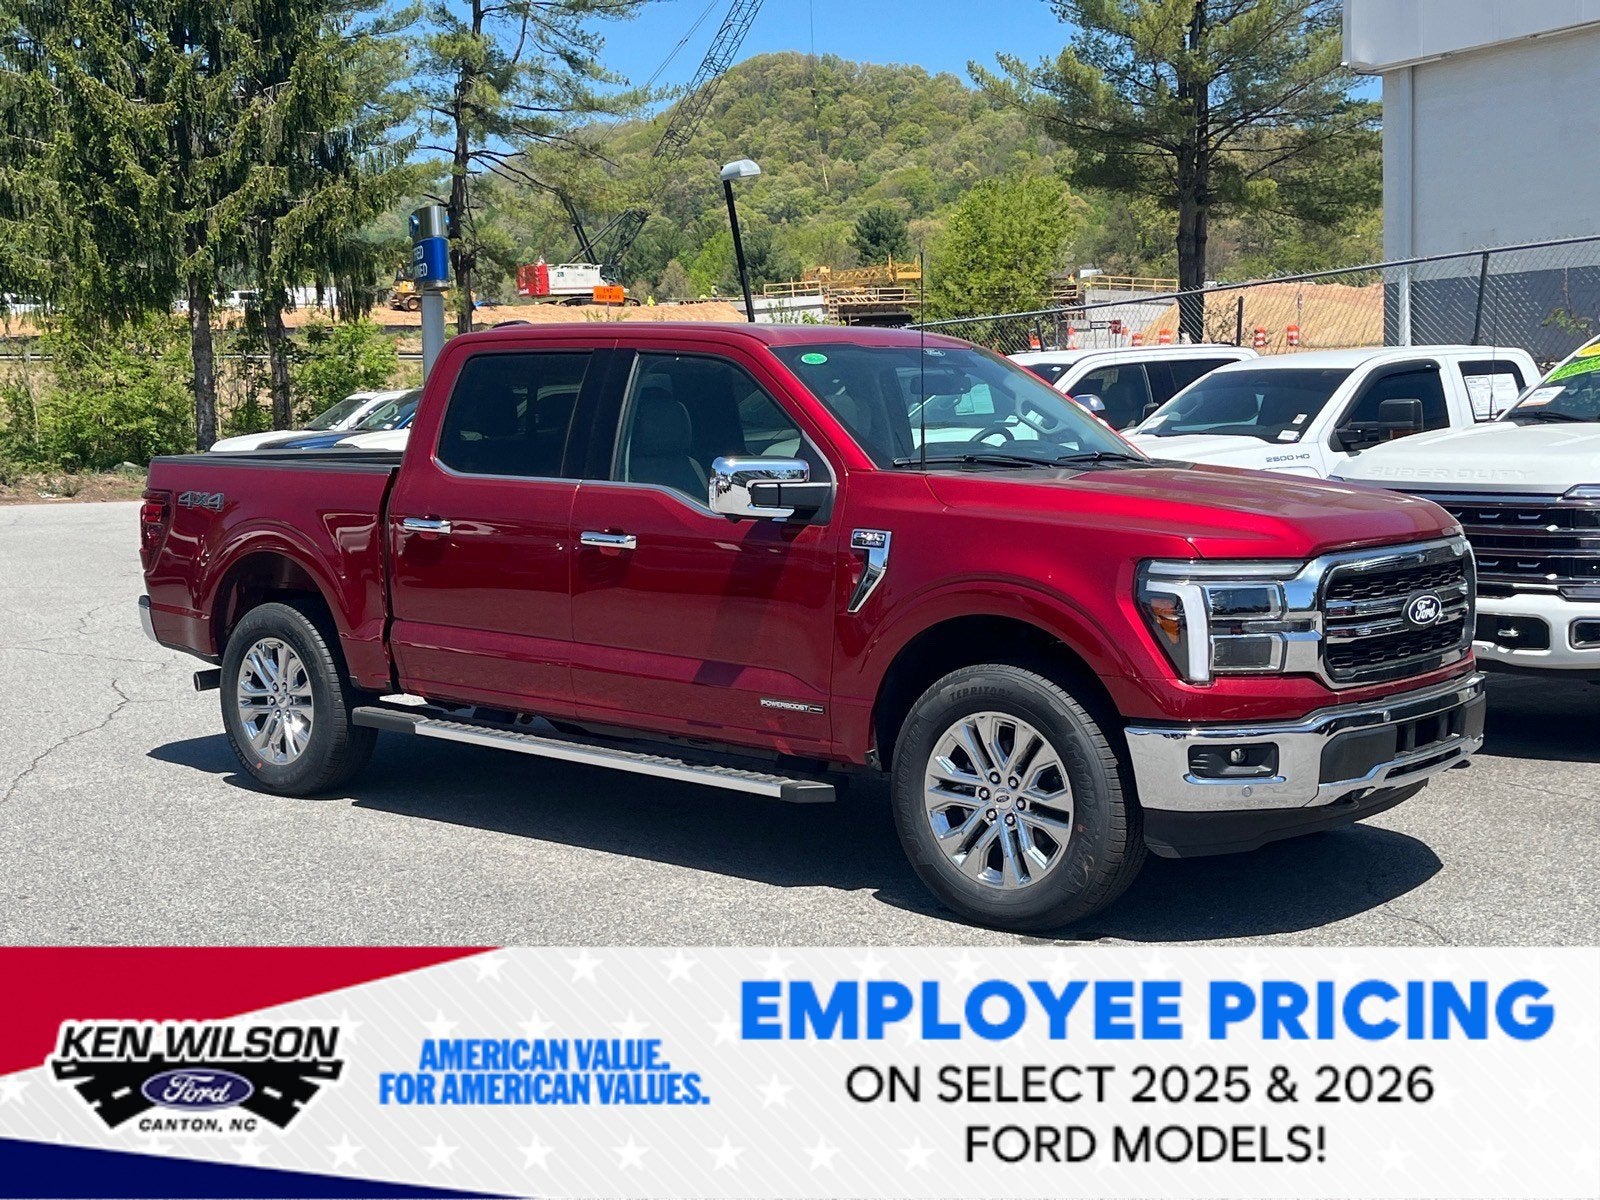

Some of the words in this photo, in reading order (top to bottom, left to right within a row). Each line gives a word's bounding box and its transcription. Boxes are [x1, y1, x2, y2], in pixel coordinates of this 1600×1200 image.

[1265, 454, 1294, 463] 2500
[1366, 466, 1449, 479] SUPER
[1455, 468, 1536, 480] DUTY
[1415, 599, 1436, 621] Ford
[949, 685, 1014, 702] TERRITORY
[760, 699, 809, 711] POWERBOOST
